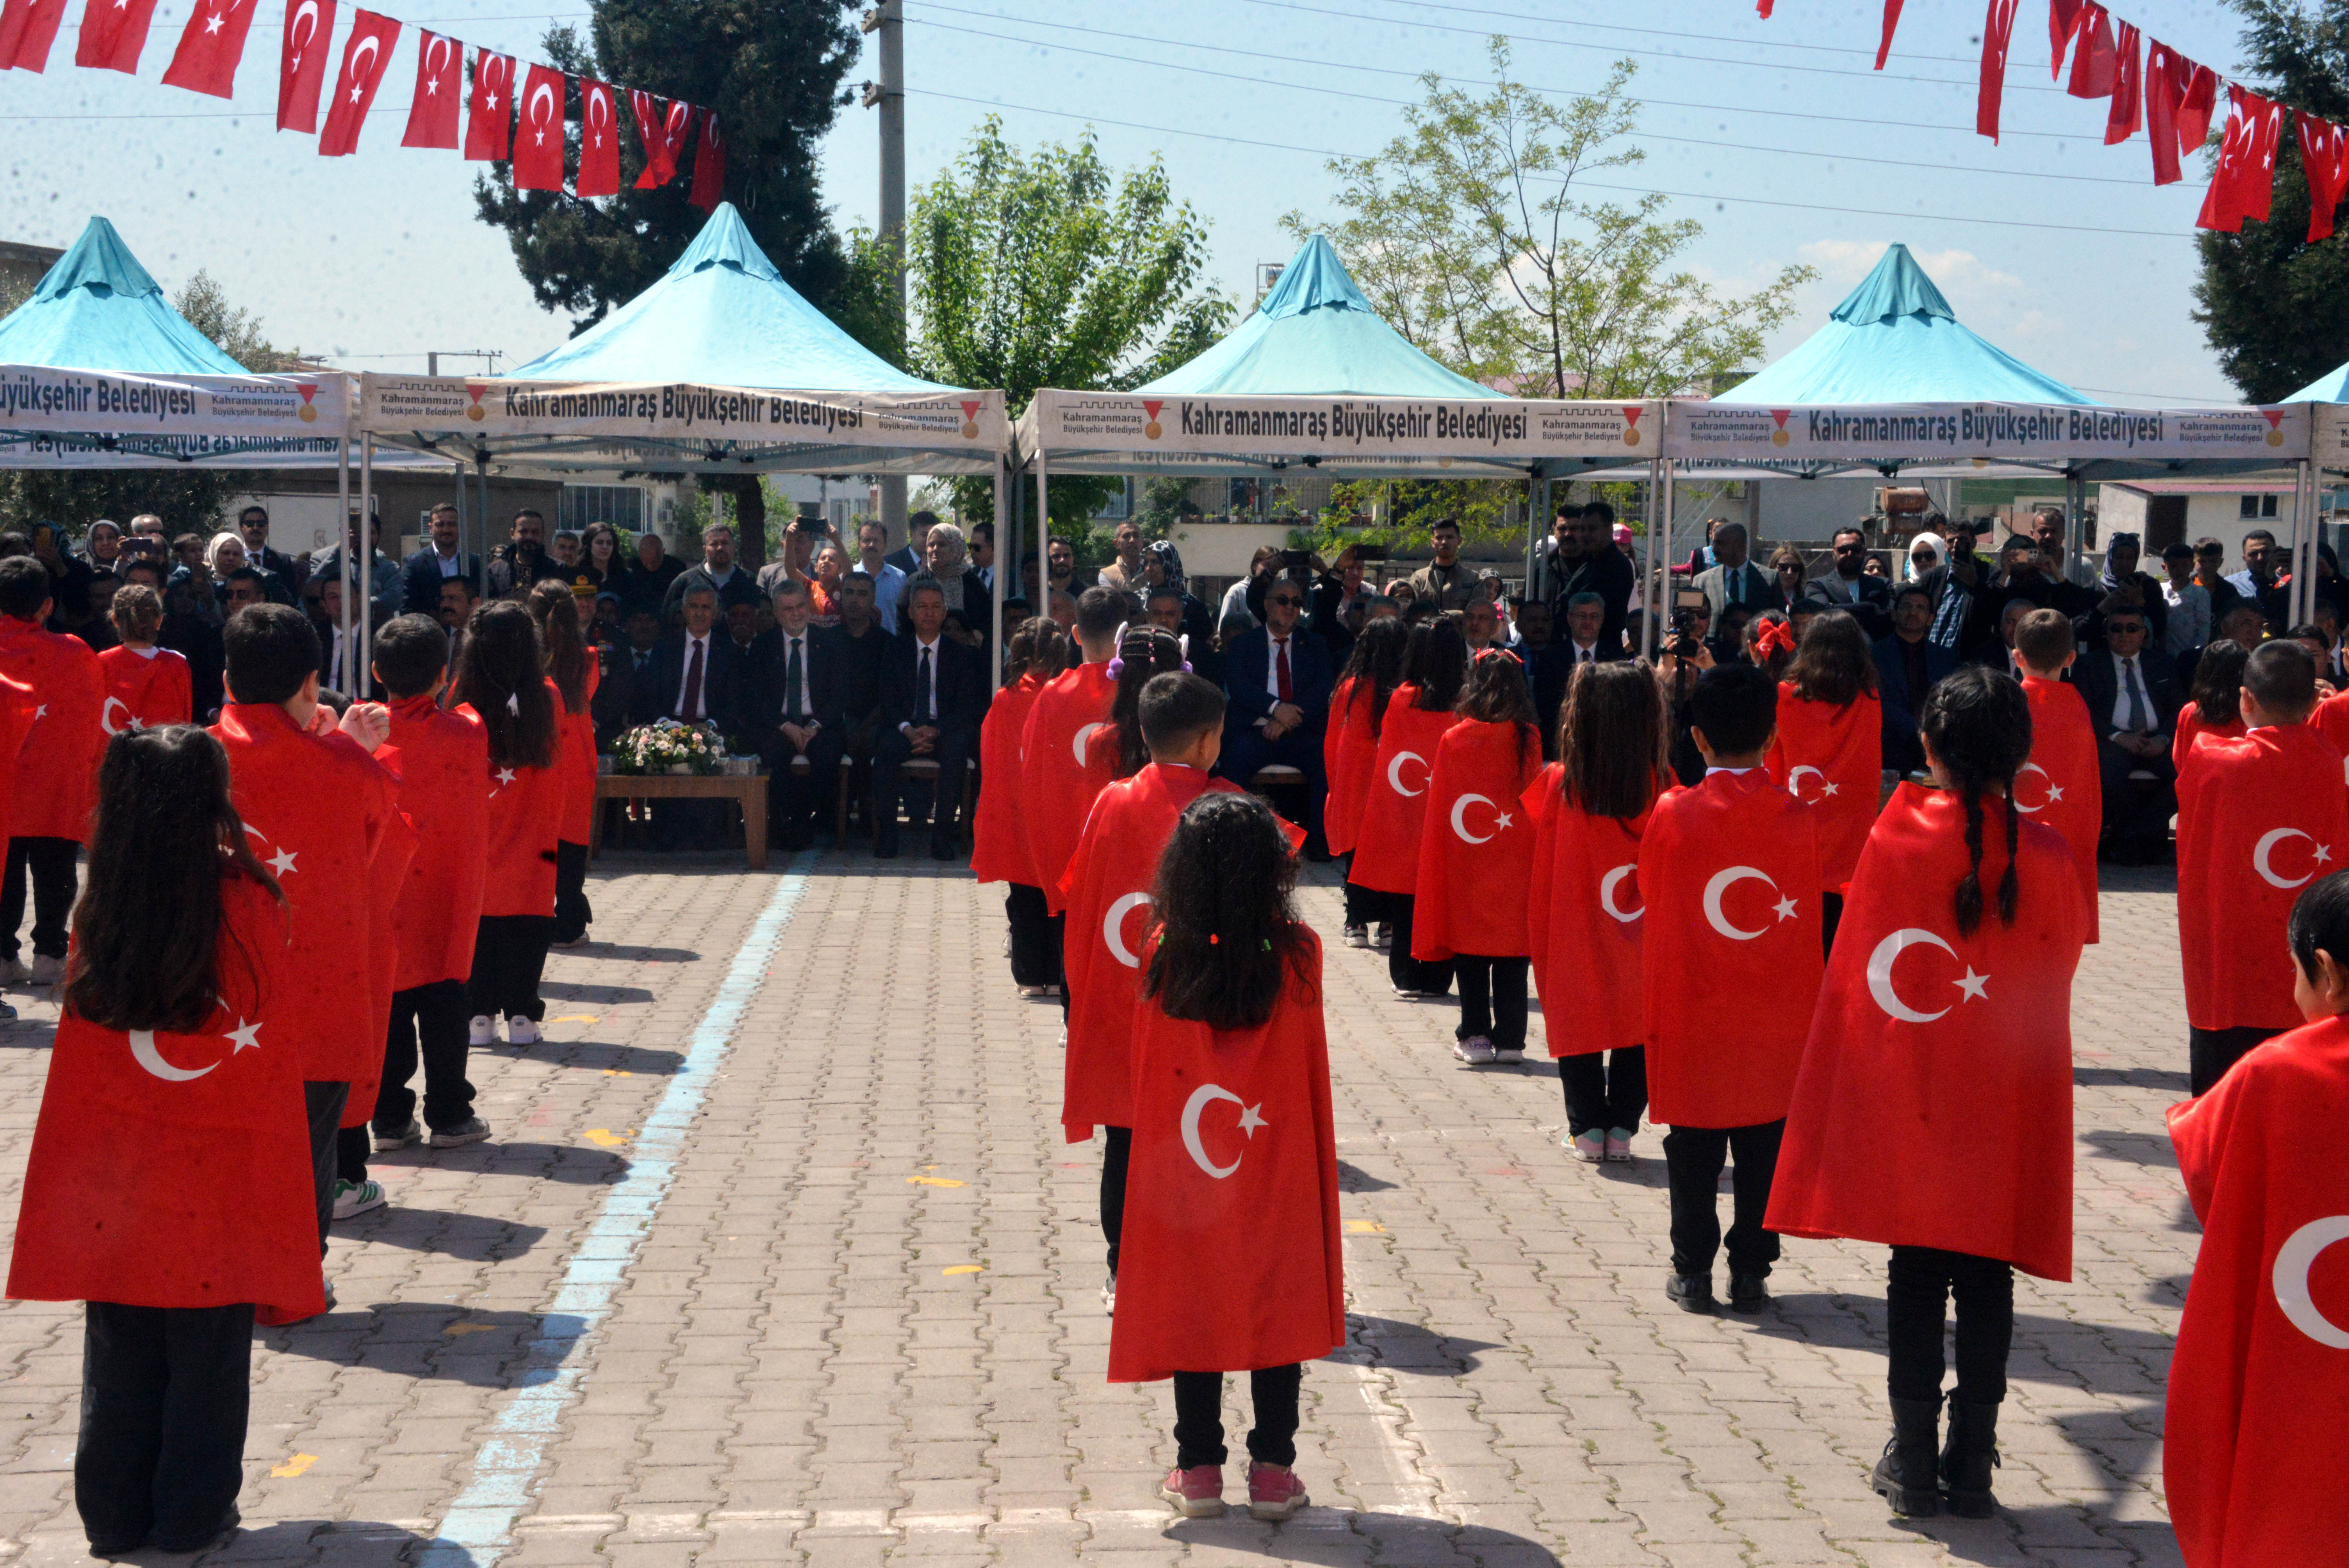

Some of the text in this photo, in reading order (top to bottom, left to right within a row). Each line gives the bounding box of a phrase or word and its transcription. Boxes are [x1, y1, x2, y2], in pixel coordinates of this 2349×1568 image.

[0, 374, 195, 422] üyükşehir Belediyesi
[212, 395, 296, 406] Kahramanmaraş
[381, 393, 464, 406] Kahramanmaraş
[212, 407, 296, 418] Büyükşehir Belediyesi
[381, 406, 464, 417] Büyükşehir Belediyesi
[506, 383, 863, 433] Kahramanmaraş Büyükşehir Belediyesi
[1063, 412, 1142, 424] Kahramanmaraş
[879, 421, 959, 434] Büyükşehir Belediyesi
[1063, 424, 1142, 436] Büyükşehir Belediyesi
[1182, 402, 1527, 447] Kahramanmaraş Büyükşehir Belediyesi
[1543, 419, 1621, 431] Kahramanmaraş
[1691, 421, 1770, 432] Kahramanmaraş
[1809, 406, 2163, 448] Kahramanmaraş Büyükşehir Belediyesi
[2180, 421, 2263, 433] Kahramanmaraş
[1543, 431, 1621, 442] Büyükşehir Belediyesi
[1691, 433, 1770, 442] Büyükşehir Belediyesi
[2179, 433, 2263, 444] Büyükşehir Belediyesi
